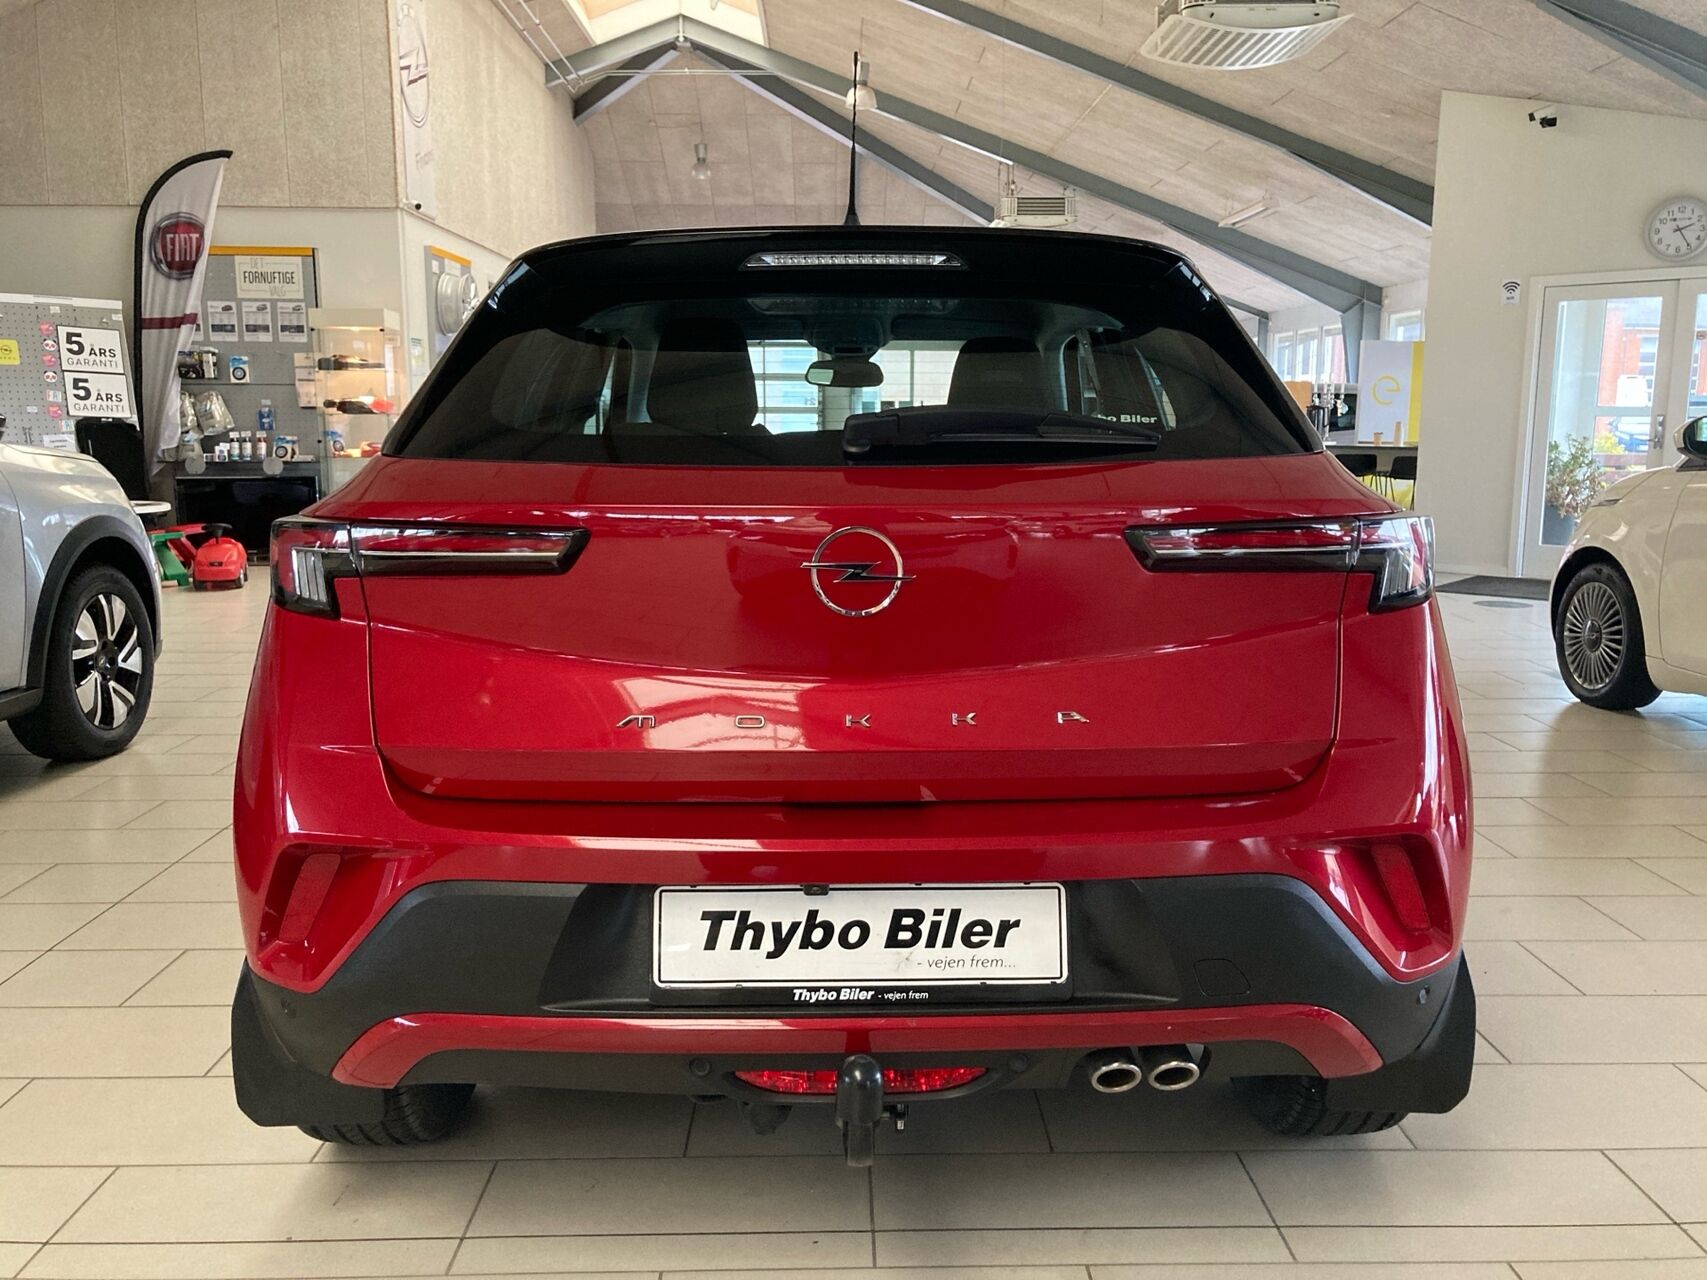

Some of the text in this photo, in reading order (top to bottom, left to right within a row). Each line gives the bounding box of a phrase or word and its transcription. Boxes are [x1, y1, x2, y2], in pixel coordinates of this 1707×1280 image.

[166, 233, 200, 262] FIAT
[243, 270, 296, 285] FORNUFTIGE
[65, 331, 117, 358] 5 ÅRS
[66, 357, 118, 368] GARANTI
[72, 377, 92, 401] 5
[73, 402, 125, 413] GARANTI
[1120, 414, 1158, 423] Biler
[699, 908, 1022, 959] Thybo Biler
[927, 956, 966, 971] vejen
[793, 988, 837, 1003] Thybo
[840, 988, 875, 1000] Biler
[884, 991, 907, 1001] vejen
[908, 990, 929, 999] frem
